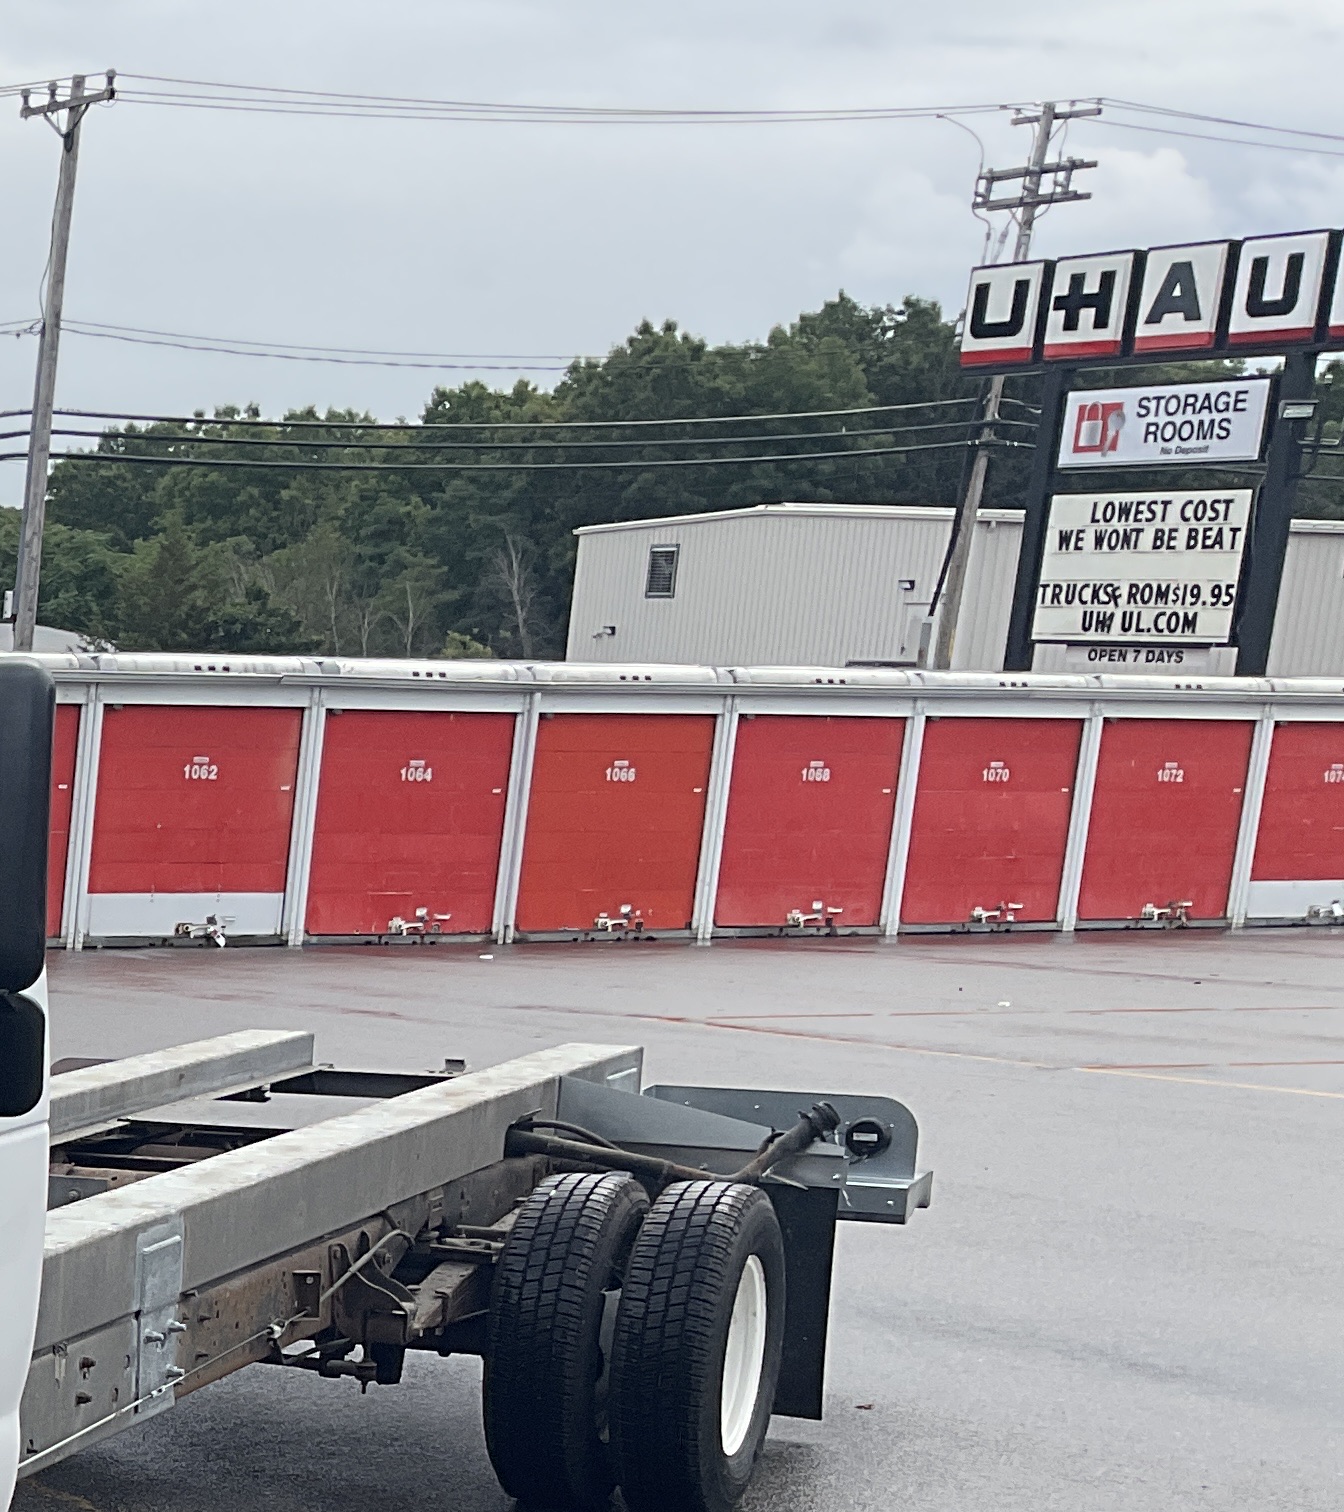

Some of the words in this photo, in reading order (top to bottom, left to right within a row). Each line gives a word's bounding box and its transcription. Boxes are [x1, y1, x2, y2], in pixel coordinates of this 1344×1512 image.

[1135, 389, 1250, 418] STORAGE
[1143, 416, 1232, 444] ROOMS
[1090, 500, 1171, 524] LOWEST
[1179, 498, 1235, 523] COST
[1057, 529, 1086, 552] WE
[1093, 528, 1144, 552] WONT
[1151, 527, 1179, 551] BE
[1185, 526, 1243, 551] BEAT
[1087, 648, 1128, 664] OPEN
[1133, 648, 1143, 663] 7
[1145, 648, 1184, 664] DAYS
[183, 764, 218, 780] 1062
[400, 766, 432, 782] 1064
[605, 767, 636, 782] 1066
[982, 768, 1010, 782] 1070
[1157, 768, 1184, 783] 1072
